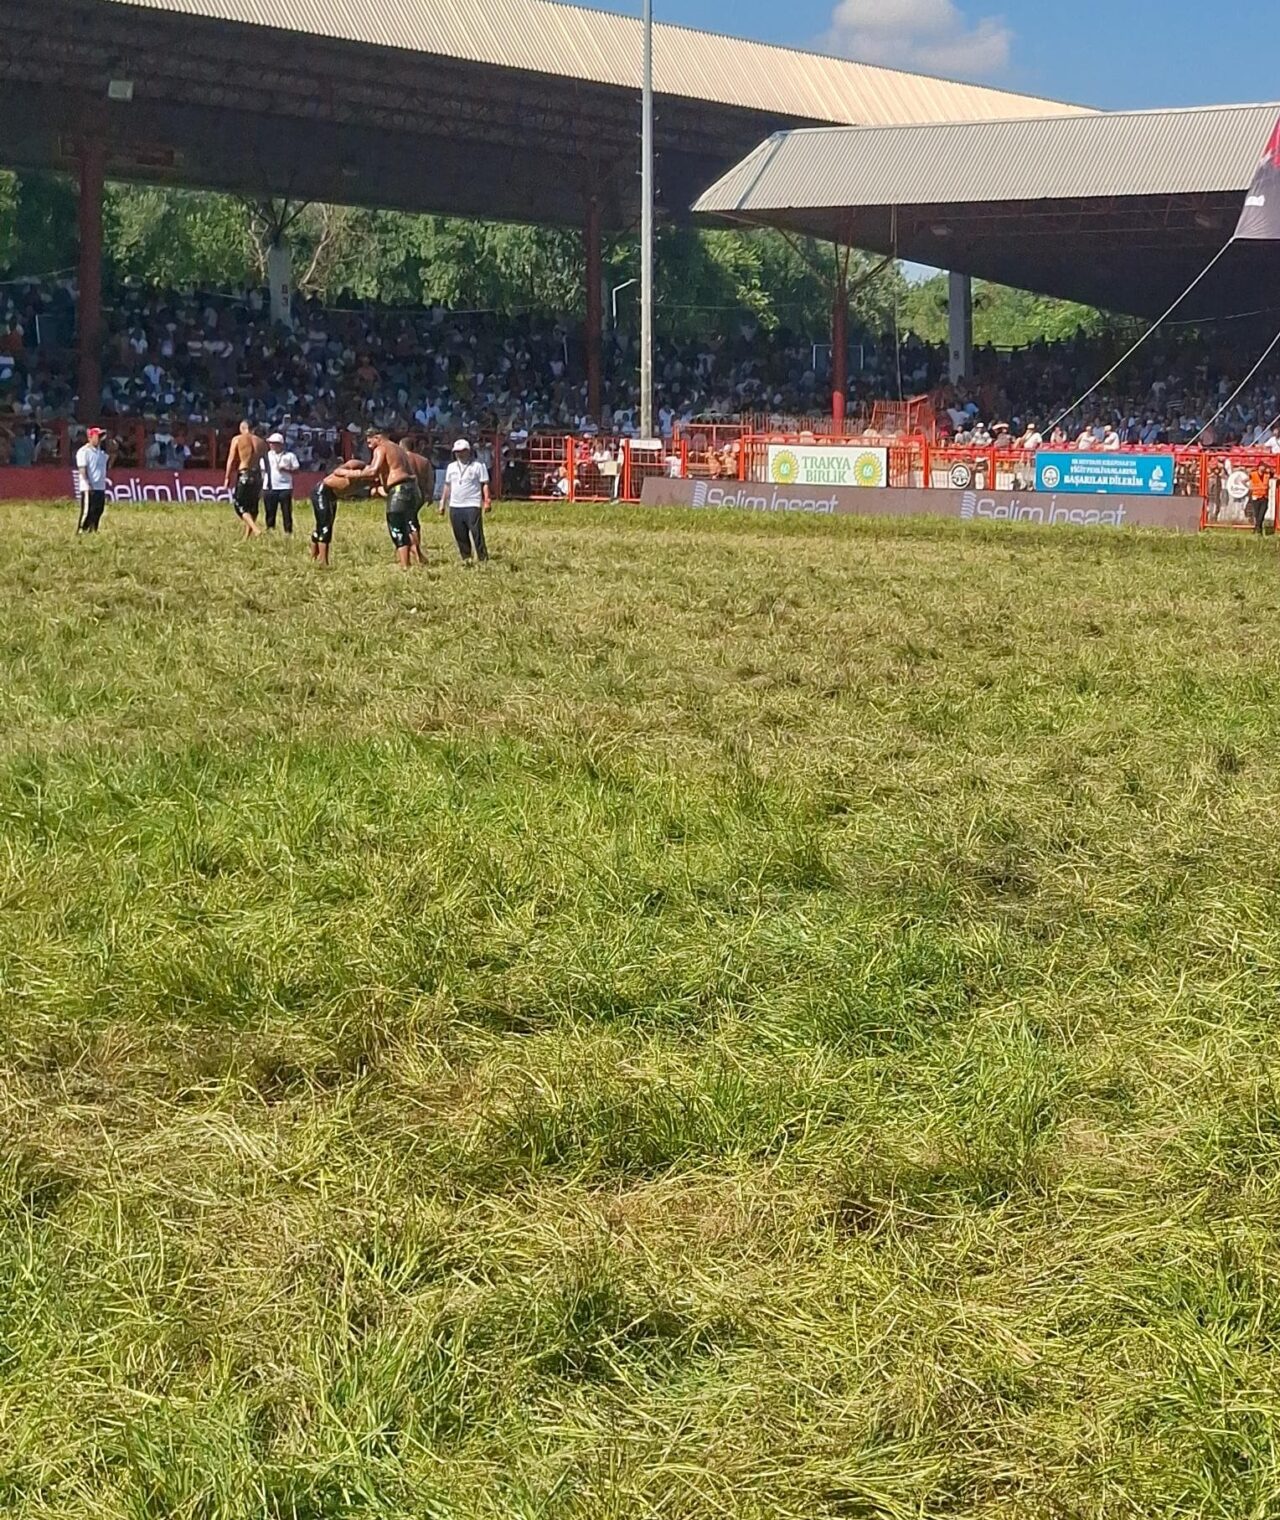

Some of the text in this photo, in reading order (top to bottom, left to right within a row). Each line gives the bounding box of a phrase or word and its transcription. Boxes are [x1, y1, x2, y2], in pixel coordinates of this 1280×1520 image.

[801, 456, 851, 470] TRAKYA
[1109, 476, 1144, 486] DİLERİM
[976, 497, 1044, 525] Selim
